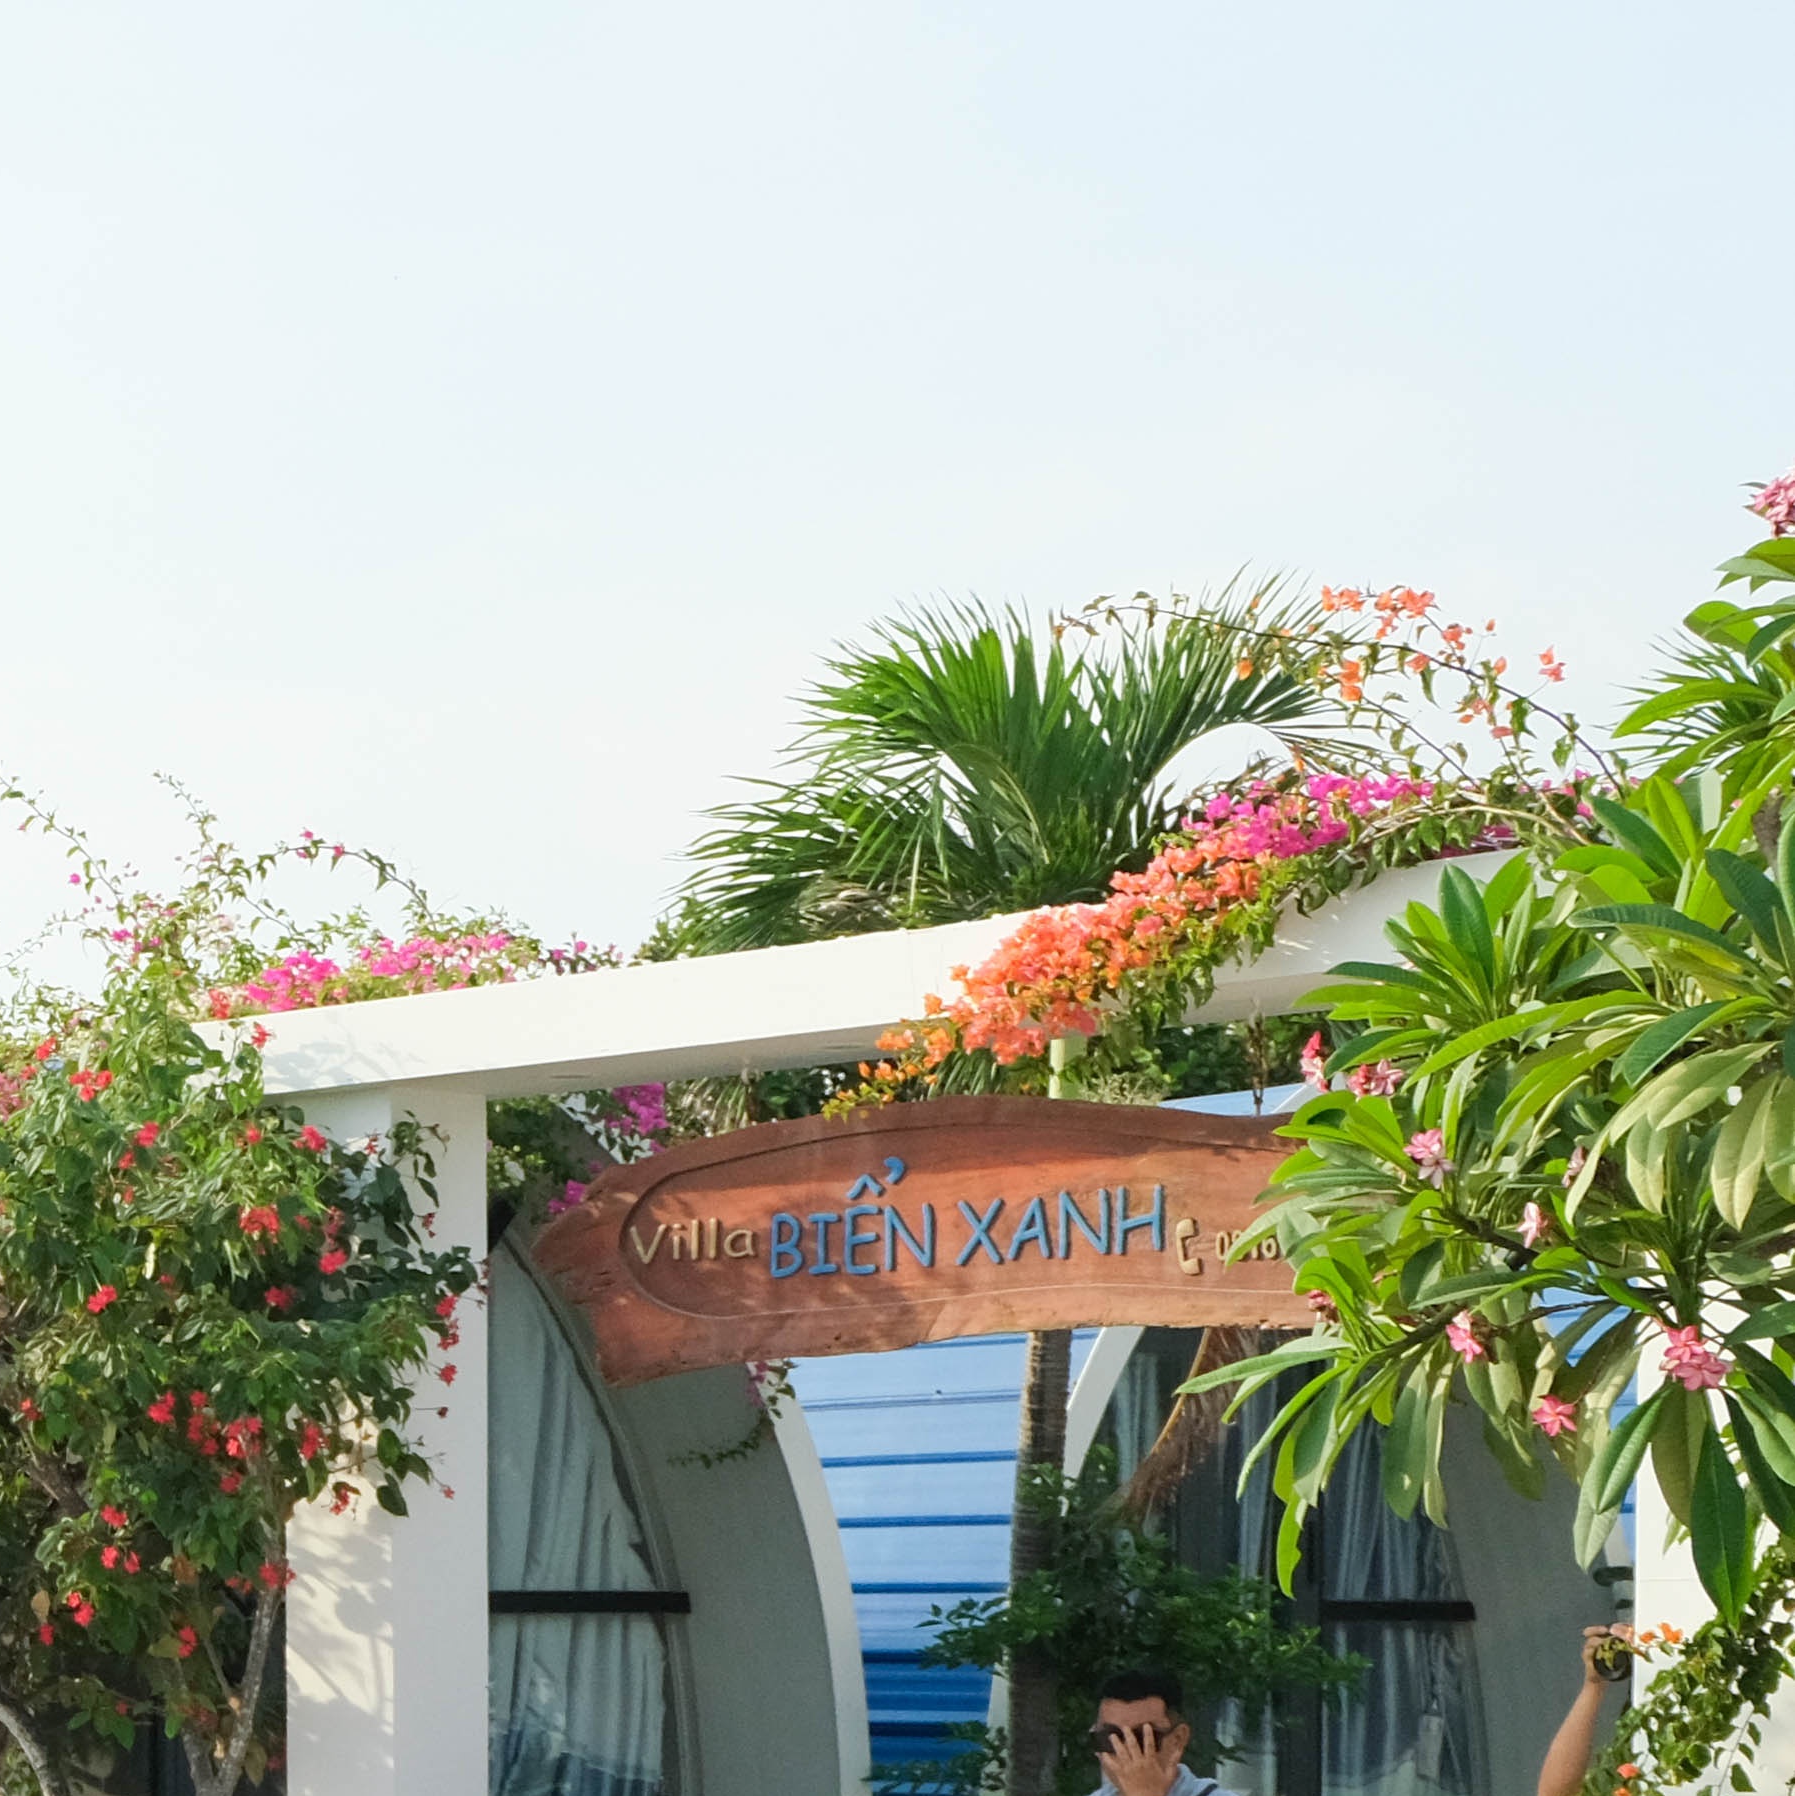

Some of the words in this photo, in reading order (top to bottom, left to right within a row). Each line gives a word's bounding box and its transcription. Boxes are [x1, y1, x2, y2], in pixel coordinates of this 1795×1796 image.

[630, 1217, 756, 1265] Villa
[770, 1156, 934, 1279] BIỂN
[955, 1183, 1164, 1267] XANH
